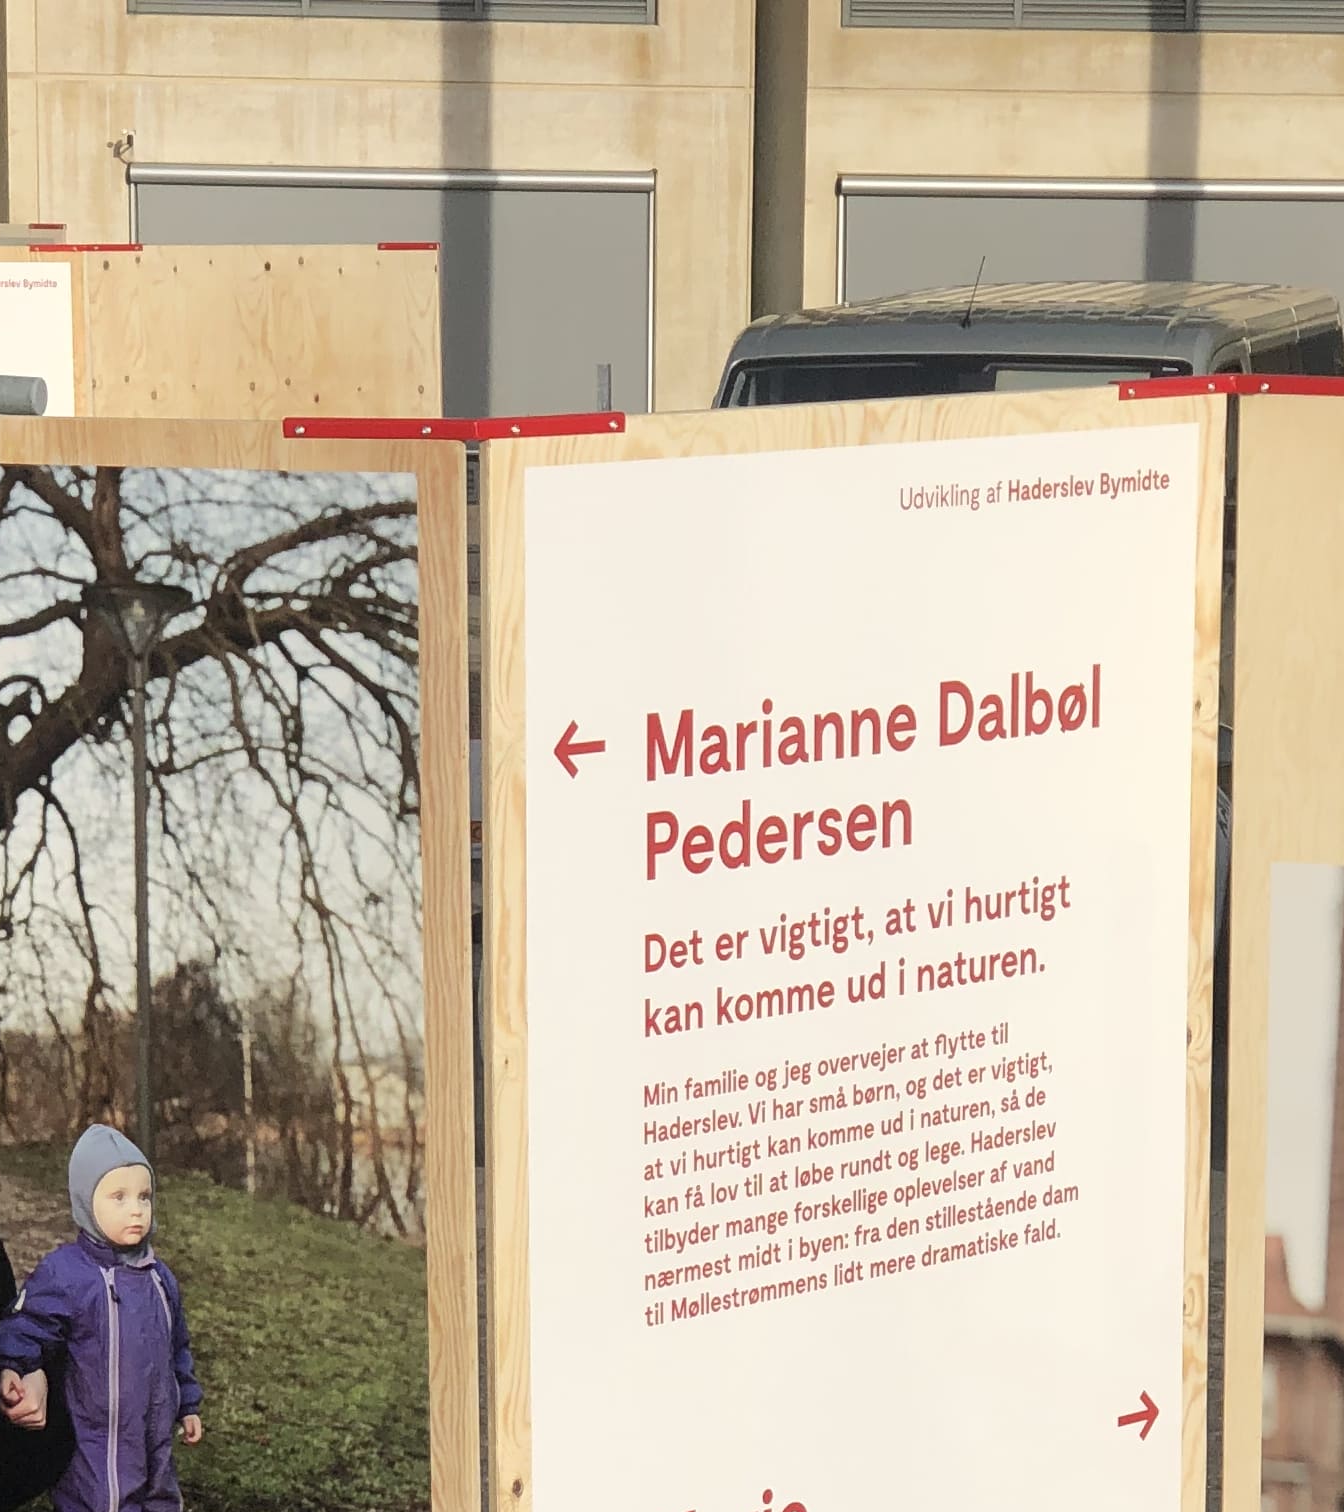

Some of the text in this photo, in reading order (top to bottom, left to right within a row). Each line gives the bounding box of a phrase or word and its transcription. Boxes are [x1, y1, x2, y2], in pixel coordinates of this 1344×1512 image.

[23, 278, 58, 290] Bymidte
[900, 469, 1170, 511] Udvikling af Haderslev Bymidte
[646, 663, 1101, 782] Marianne Dalbøl
[646, 798, 913, 881] Pedersen
[644, 875, 1071, 974] Det er vigtigt, at vi hurtigt
[644, 947, 1046, 1038] kan komme ud i naturen.
[643, 1021, 1009, 1108] Min familie og jeg overvejer at flytte til
[643, 1051, 1053, 1145] Haderslev. Vi har små børn, og det er vigtigt,
[643, 1085, 1047, 1182] at vi hurtigt kan komme ud i naturen, så de
[644, 1119, 1057, 1219] kan få lov til at løbe rundt og lege. Haderslev
[643, 1149, 1055, 1255] tilbyder mange forskellige oplevelser af vand
[644, 1184, 1079, 1292] nærmest midt i byen: fra den stillestående dam
[644, 1217, 1061, 1327] til Møllestrømmens lidt mere dramatiske fald.
